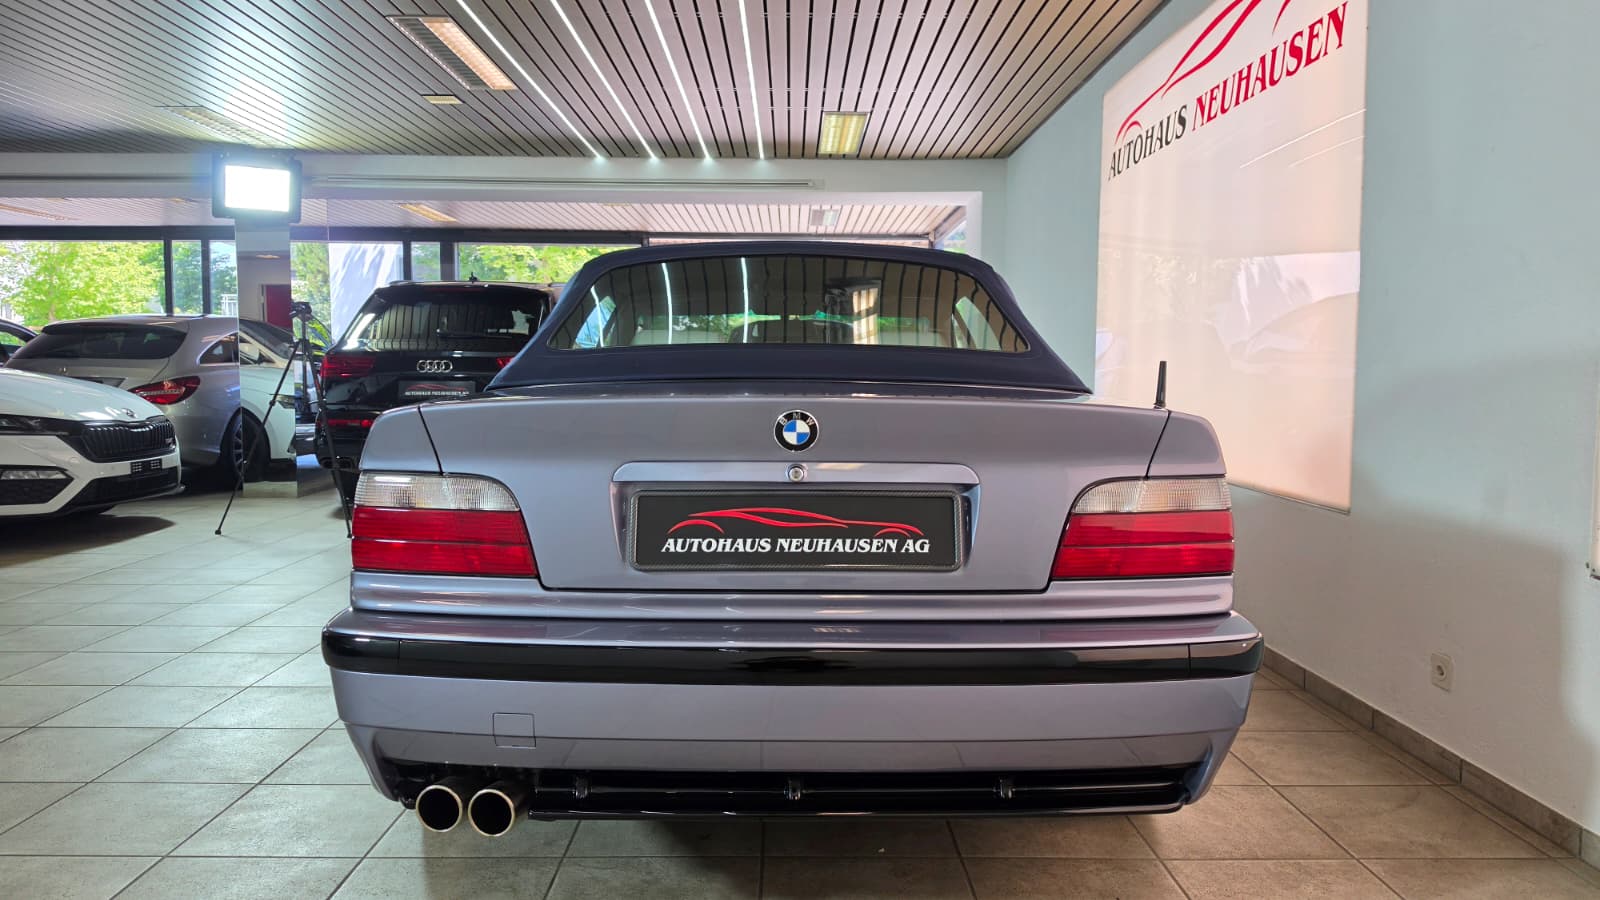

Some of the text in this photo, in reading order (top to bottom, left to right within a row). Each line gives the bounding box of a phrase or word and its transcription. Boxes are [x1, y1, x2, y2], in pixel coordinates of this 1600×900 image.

[1108, 1, 1348, 181] AUTOHAUS NEUHAUSEN
[779, 412, 816, 426] BMW
[661, 538, 930, 553] AUTOHAUS NEUHAUSEN AG
